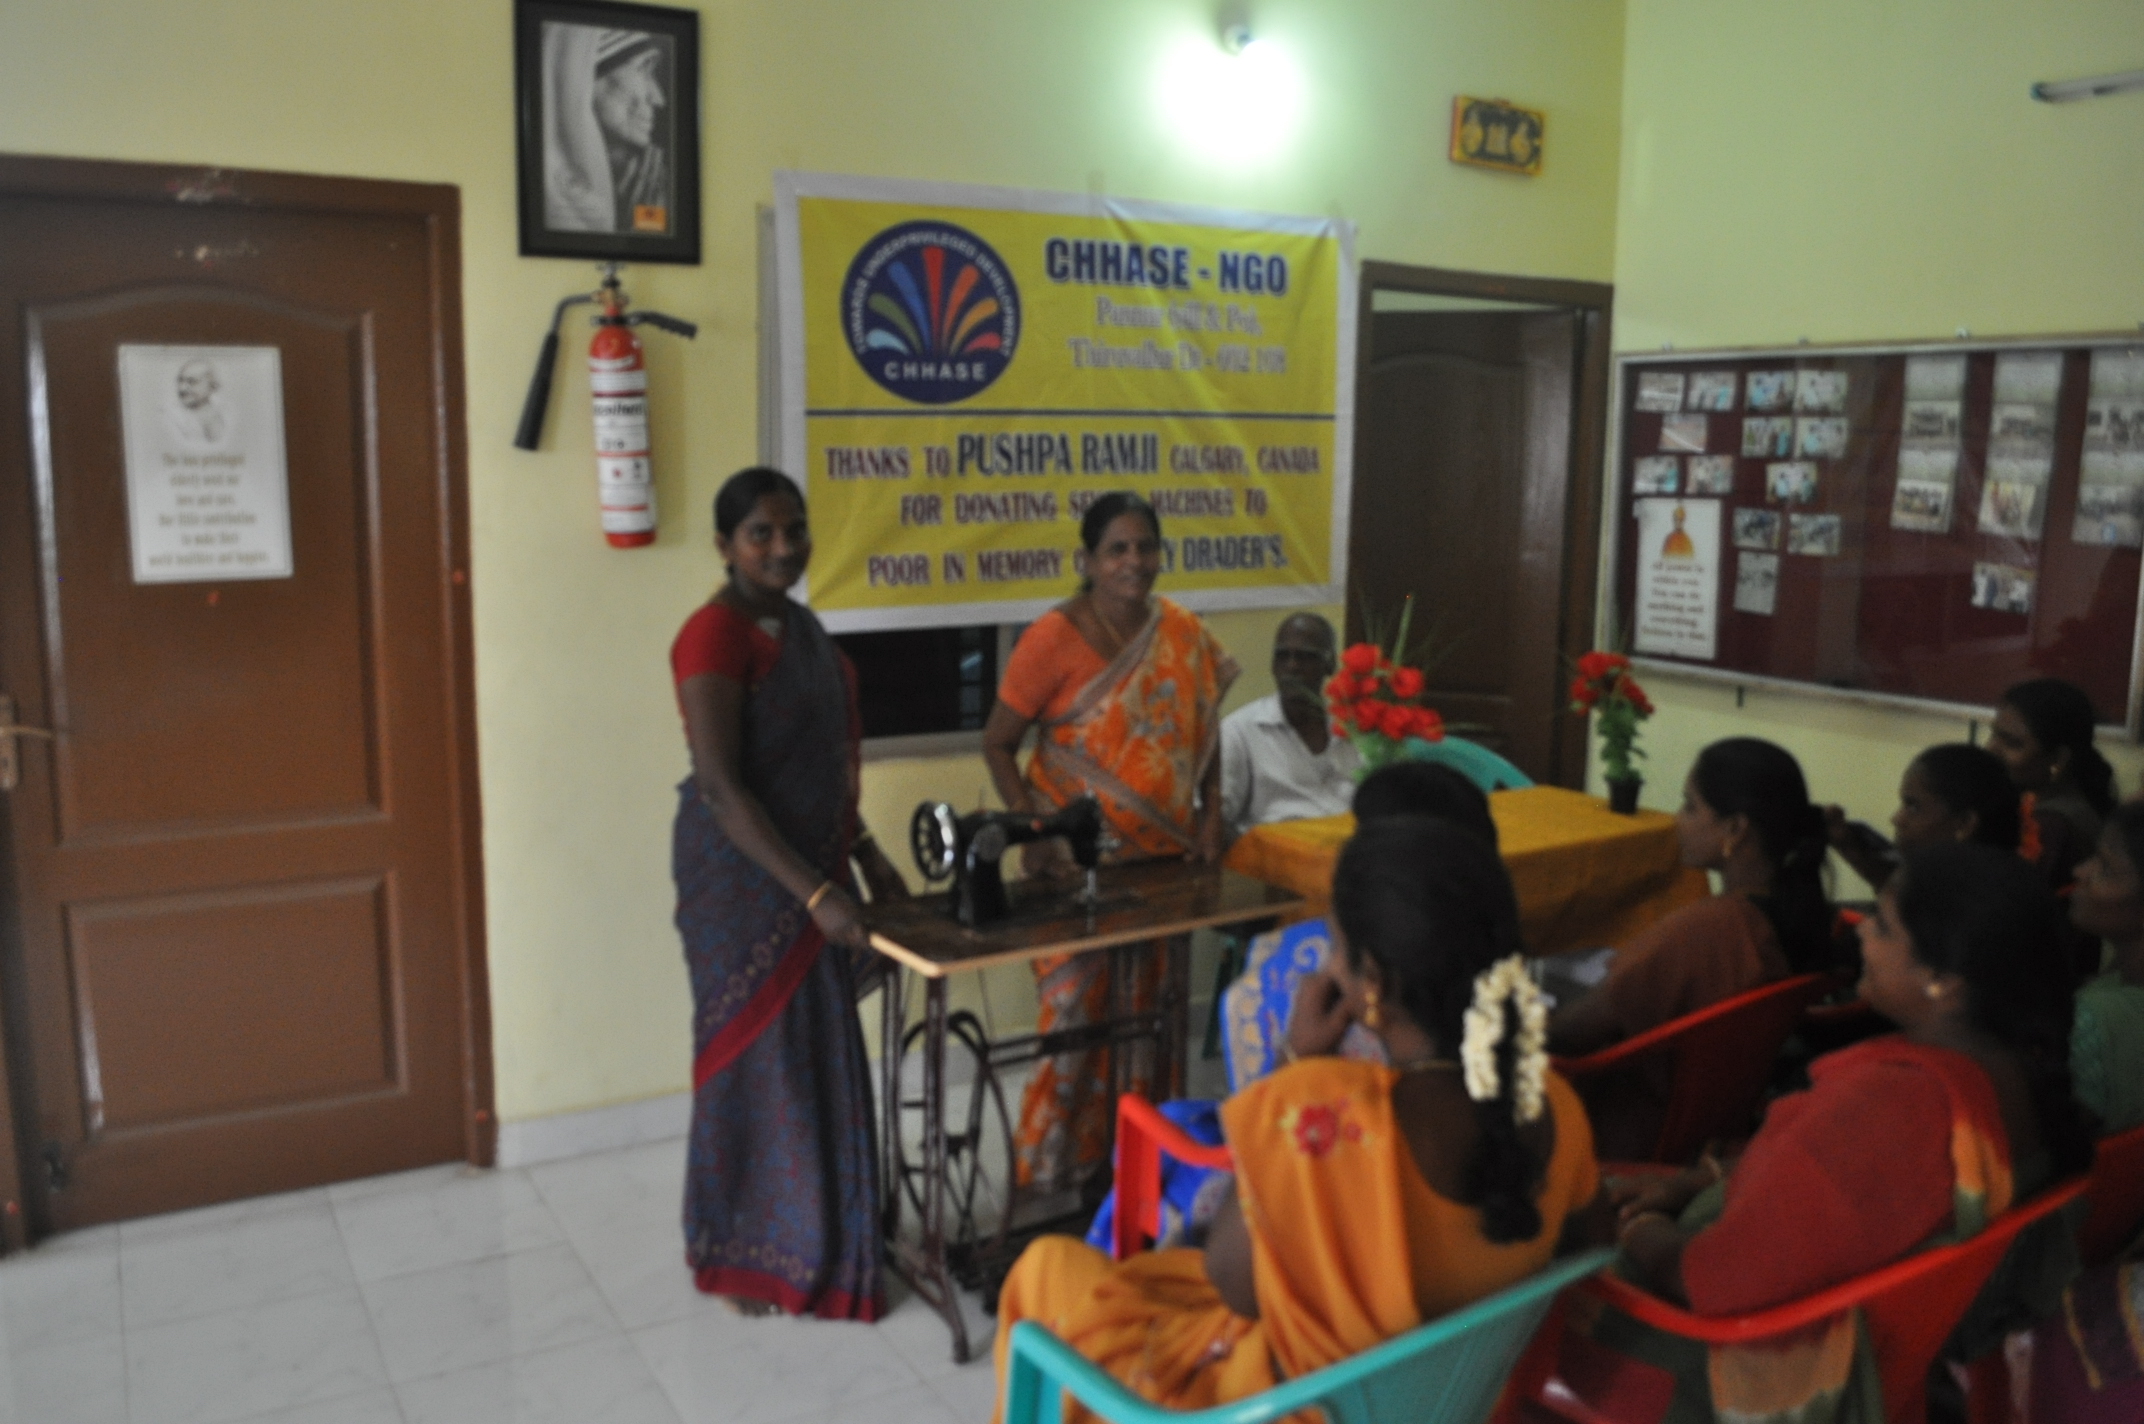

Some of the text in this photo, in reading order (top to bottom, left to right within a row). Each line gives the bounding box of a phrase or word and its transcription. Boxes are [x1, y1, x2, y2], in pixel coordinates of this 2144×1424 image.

[1045, 237, 1191, 291] CHHASE
[1219, 252, 1288, 297] NGO
[884, 361, 986, 381] CHHASE
[825, 446, 911, 480] THANKS
[923, 446, 950, 477] TO
[957, 433, 1074, 477] PUSHPA
[1082, 433, 1159, 475] RAMJI
[1257, 445, 1320, 474] CANADA
[901, 494, 942, 525] FOR
[955, 492, 1058, 523] DONATING
[1245, 488, 1267, 516] TO
[868, 554, 930, 587] POOR
[944, 552, 966, 583] IN
[977, 549, 1062, 583] MEMORY
